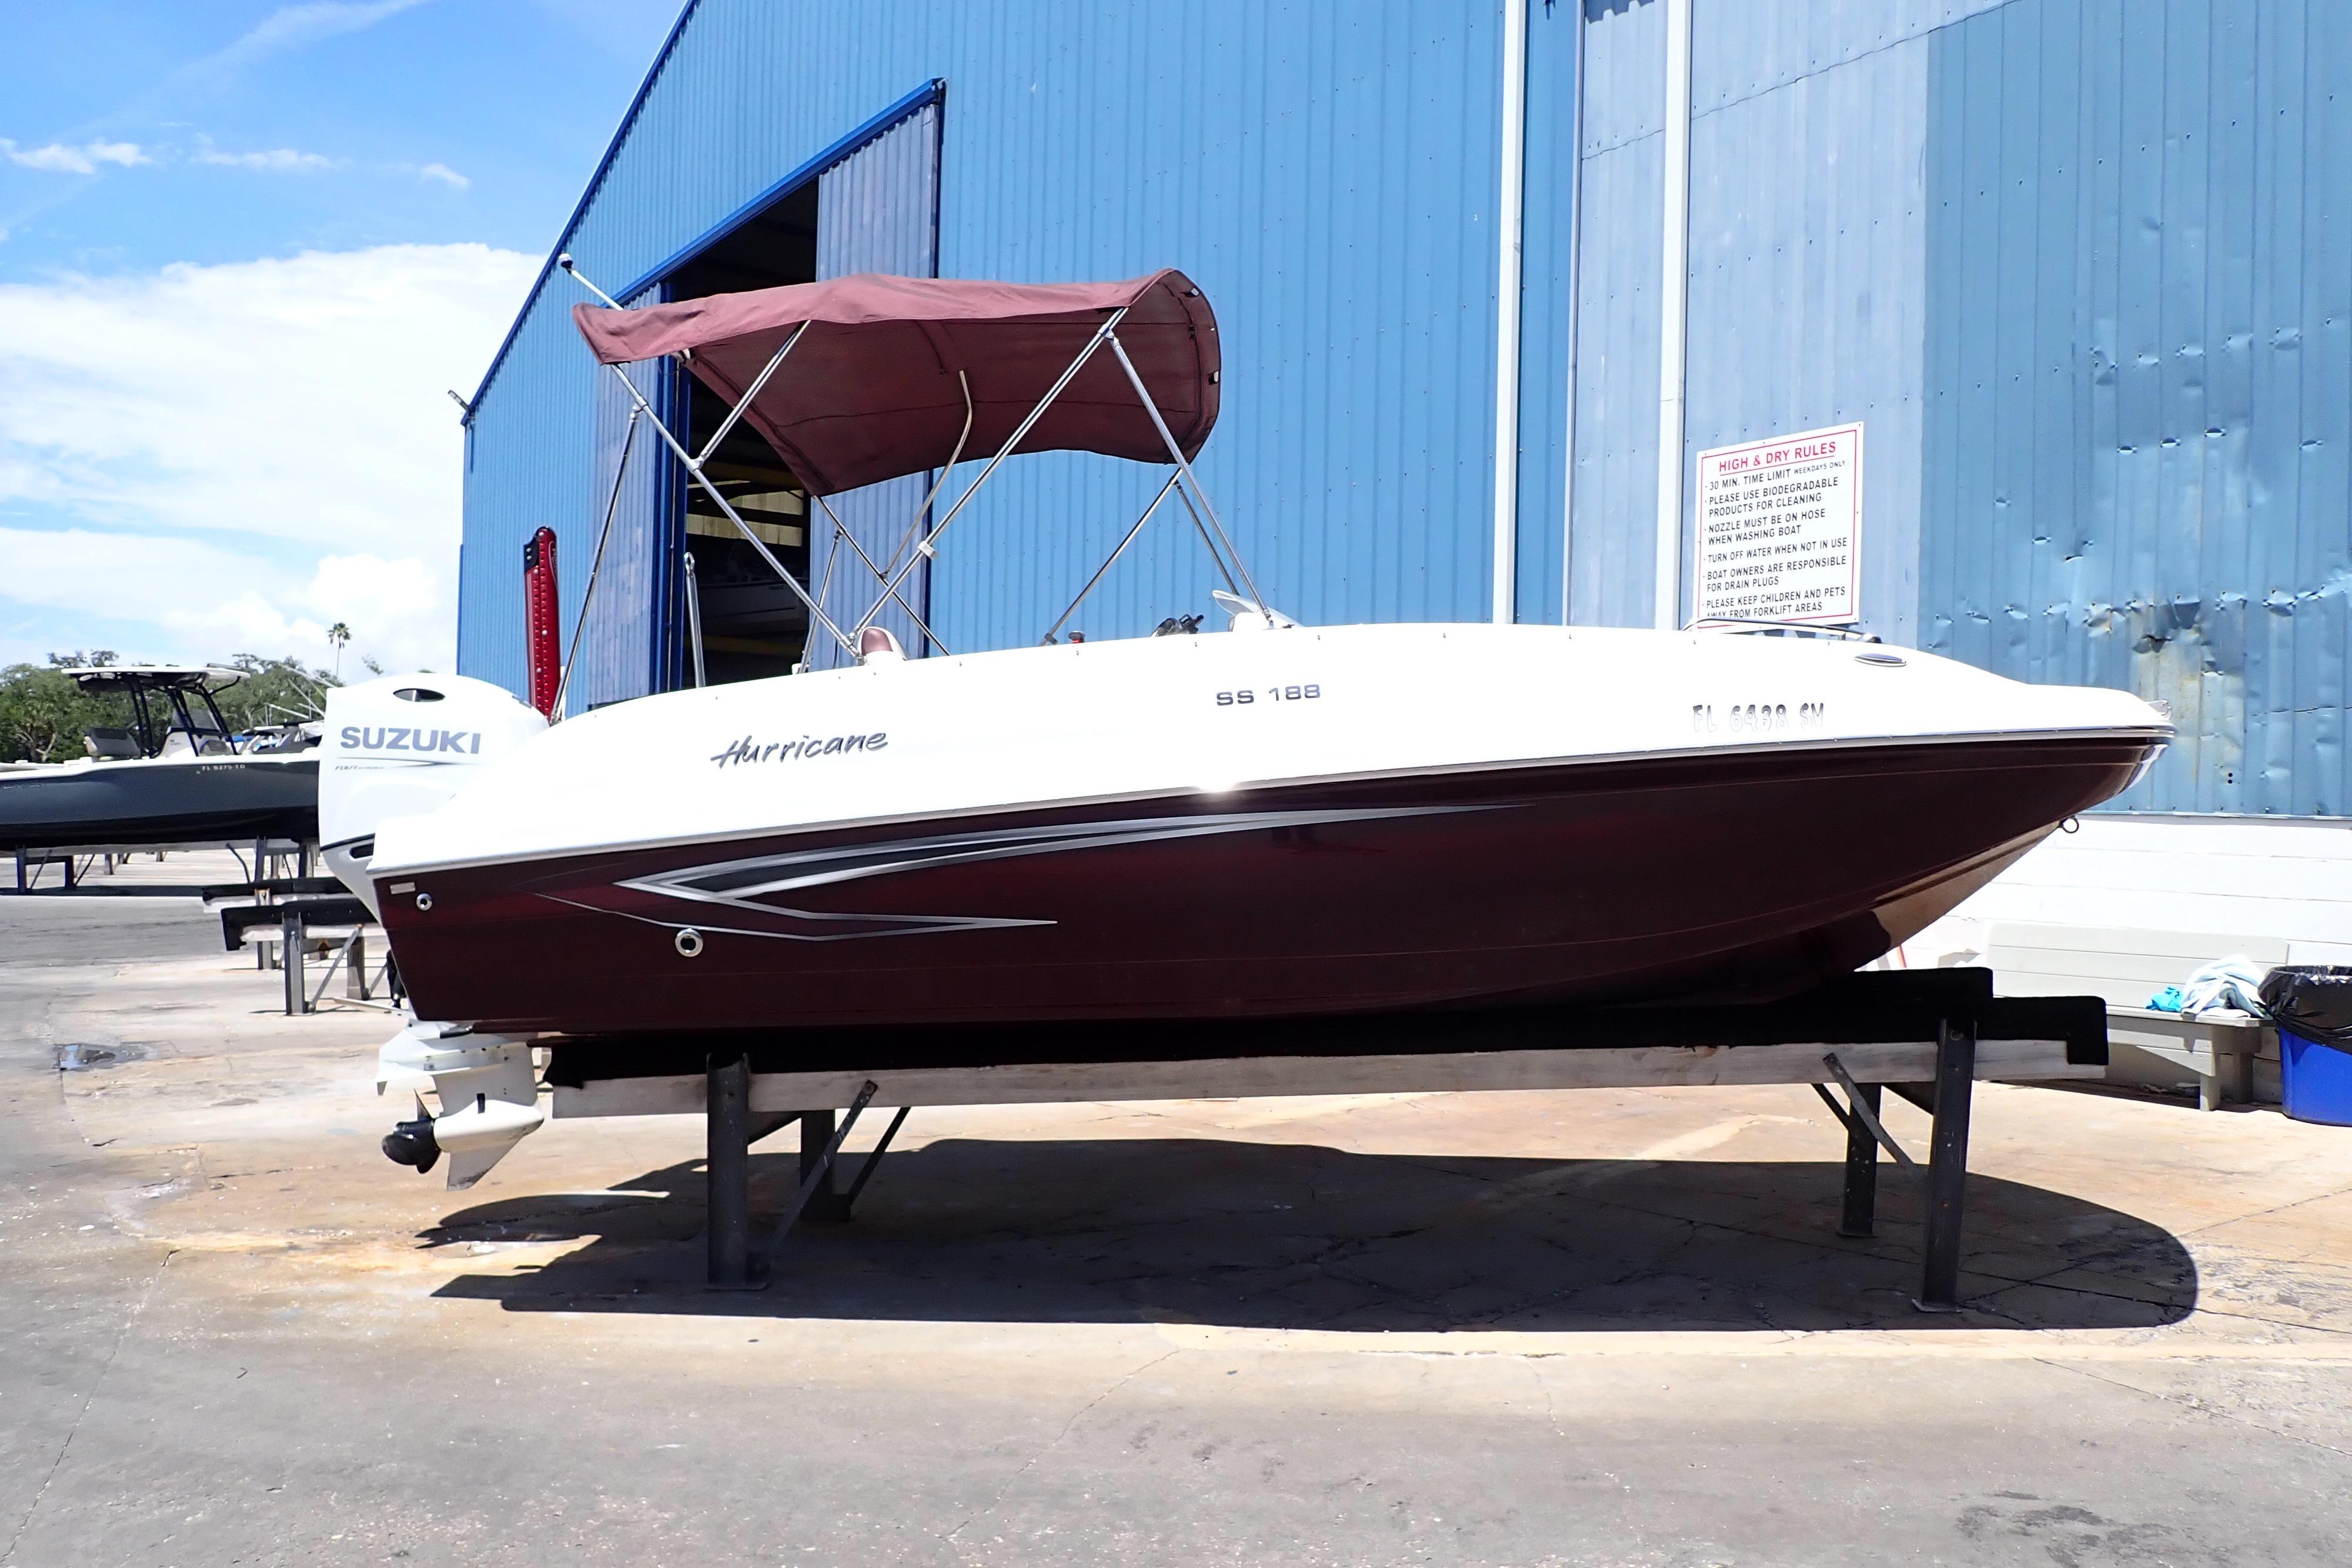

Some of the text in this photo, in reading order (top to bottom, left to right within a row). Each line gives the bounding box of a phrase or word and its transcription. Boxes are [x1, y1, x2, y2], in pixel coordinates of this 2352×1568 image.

[1719, 442, 1835, 472] HIGH & DRY RULES
[1710, 460, 1845, 490] 30 MIN. TIME LIMIT WEEKDAYS ONLY
[1709, 477, 1838, 505] PLEASE USE BIODEGRADABLE
[1709, 492, 1822, 517] PRODUCTS FOR CLEANING
[1709, 508, 1825, 533] NOZZLE MUST BE ON HOSE
[1709, 525, 1801, 546] WHEN WASHING BOAT
[1708, 537, 1847, 563] TURN OFF WATER WHEN NOT IN USE
[1708, 556, 1846, 580] BOAT OWNERS ARE RESPONSIBLE
[1707, 576, 1779, 593] FOR DRAIN PLUGS
[1706, 586, 1845, 609] PLEASE KEEP CHILDREN AND PETS
[1730, 609, 1750, 618] FROM
[1754, 604, 1792, 617] FORKLIFT
[1795, 601, 1822, 613] AREAS
[1216, 684, 1321, 706] SS 188
[1693, 704, 1718, 733] FL
[340, 726, 481, 754] SUZUKI
[710, 733, 888, 770] Hurricane
